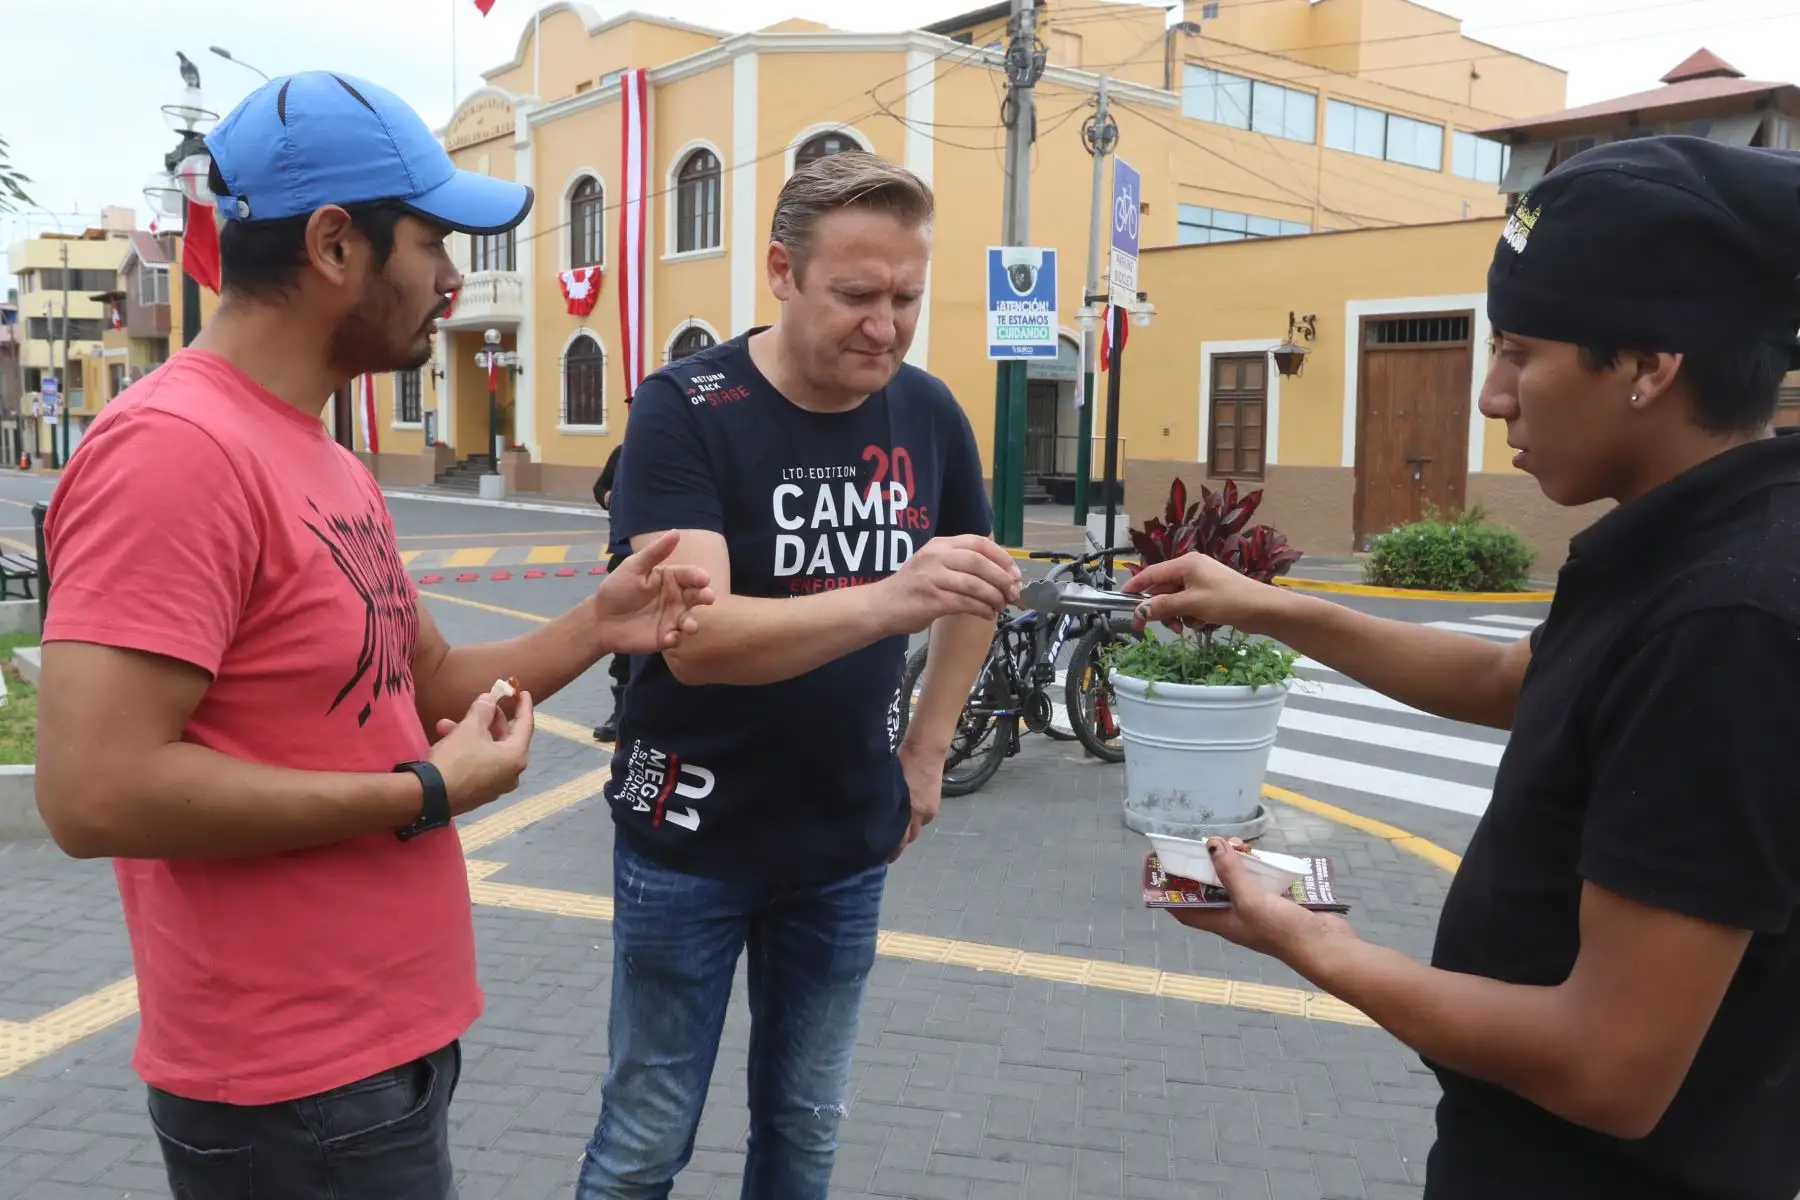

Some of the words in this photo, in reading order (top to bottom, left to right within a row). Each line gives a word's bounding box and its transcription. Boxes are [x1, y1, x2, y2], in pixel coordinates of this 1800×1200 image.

[996, 297, 1049, 312] ¡ATENCIÓN!
[997, 315, 1006, 325] TE
[1008, 315, 1049, 325] ESTAMOS
[998, 327, 1048, 338] CUIDANDO
[690, 373, 725, 384] RETURN
[691, 394, 706, 405] ON
[706, 385, 750, 407] STAGE
[698, 382, 722, 392] BACK
[862, 444, 916, 502] 20
[772, 481, 909, 530] CAMP
[773, 529, 914, 577] DAVID
[625, 750, 648, 803] STRONG
[632, 748, 667, 812] MEGA
[664, 763, 716, 832] 01
